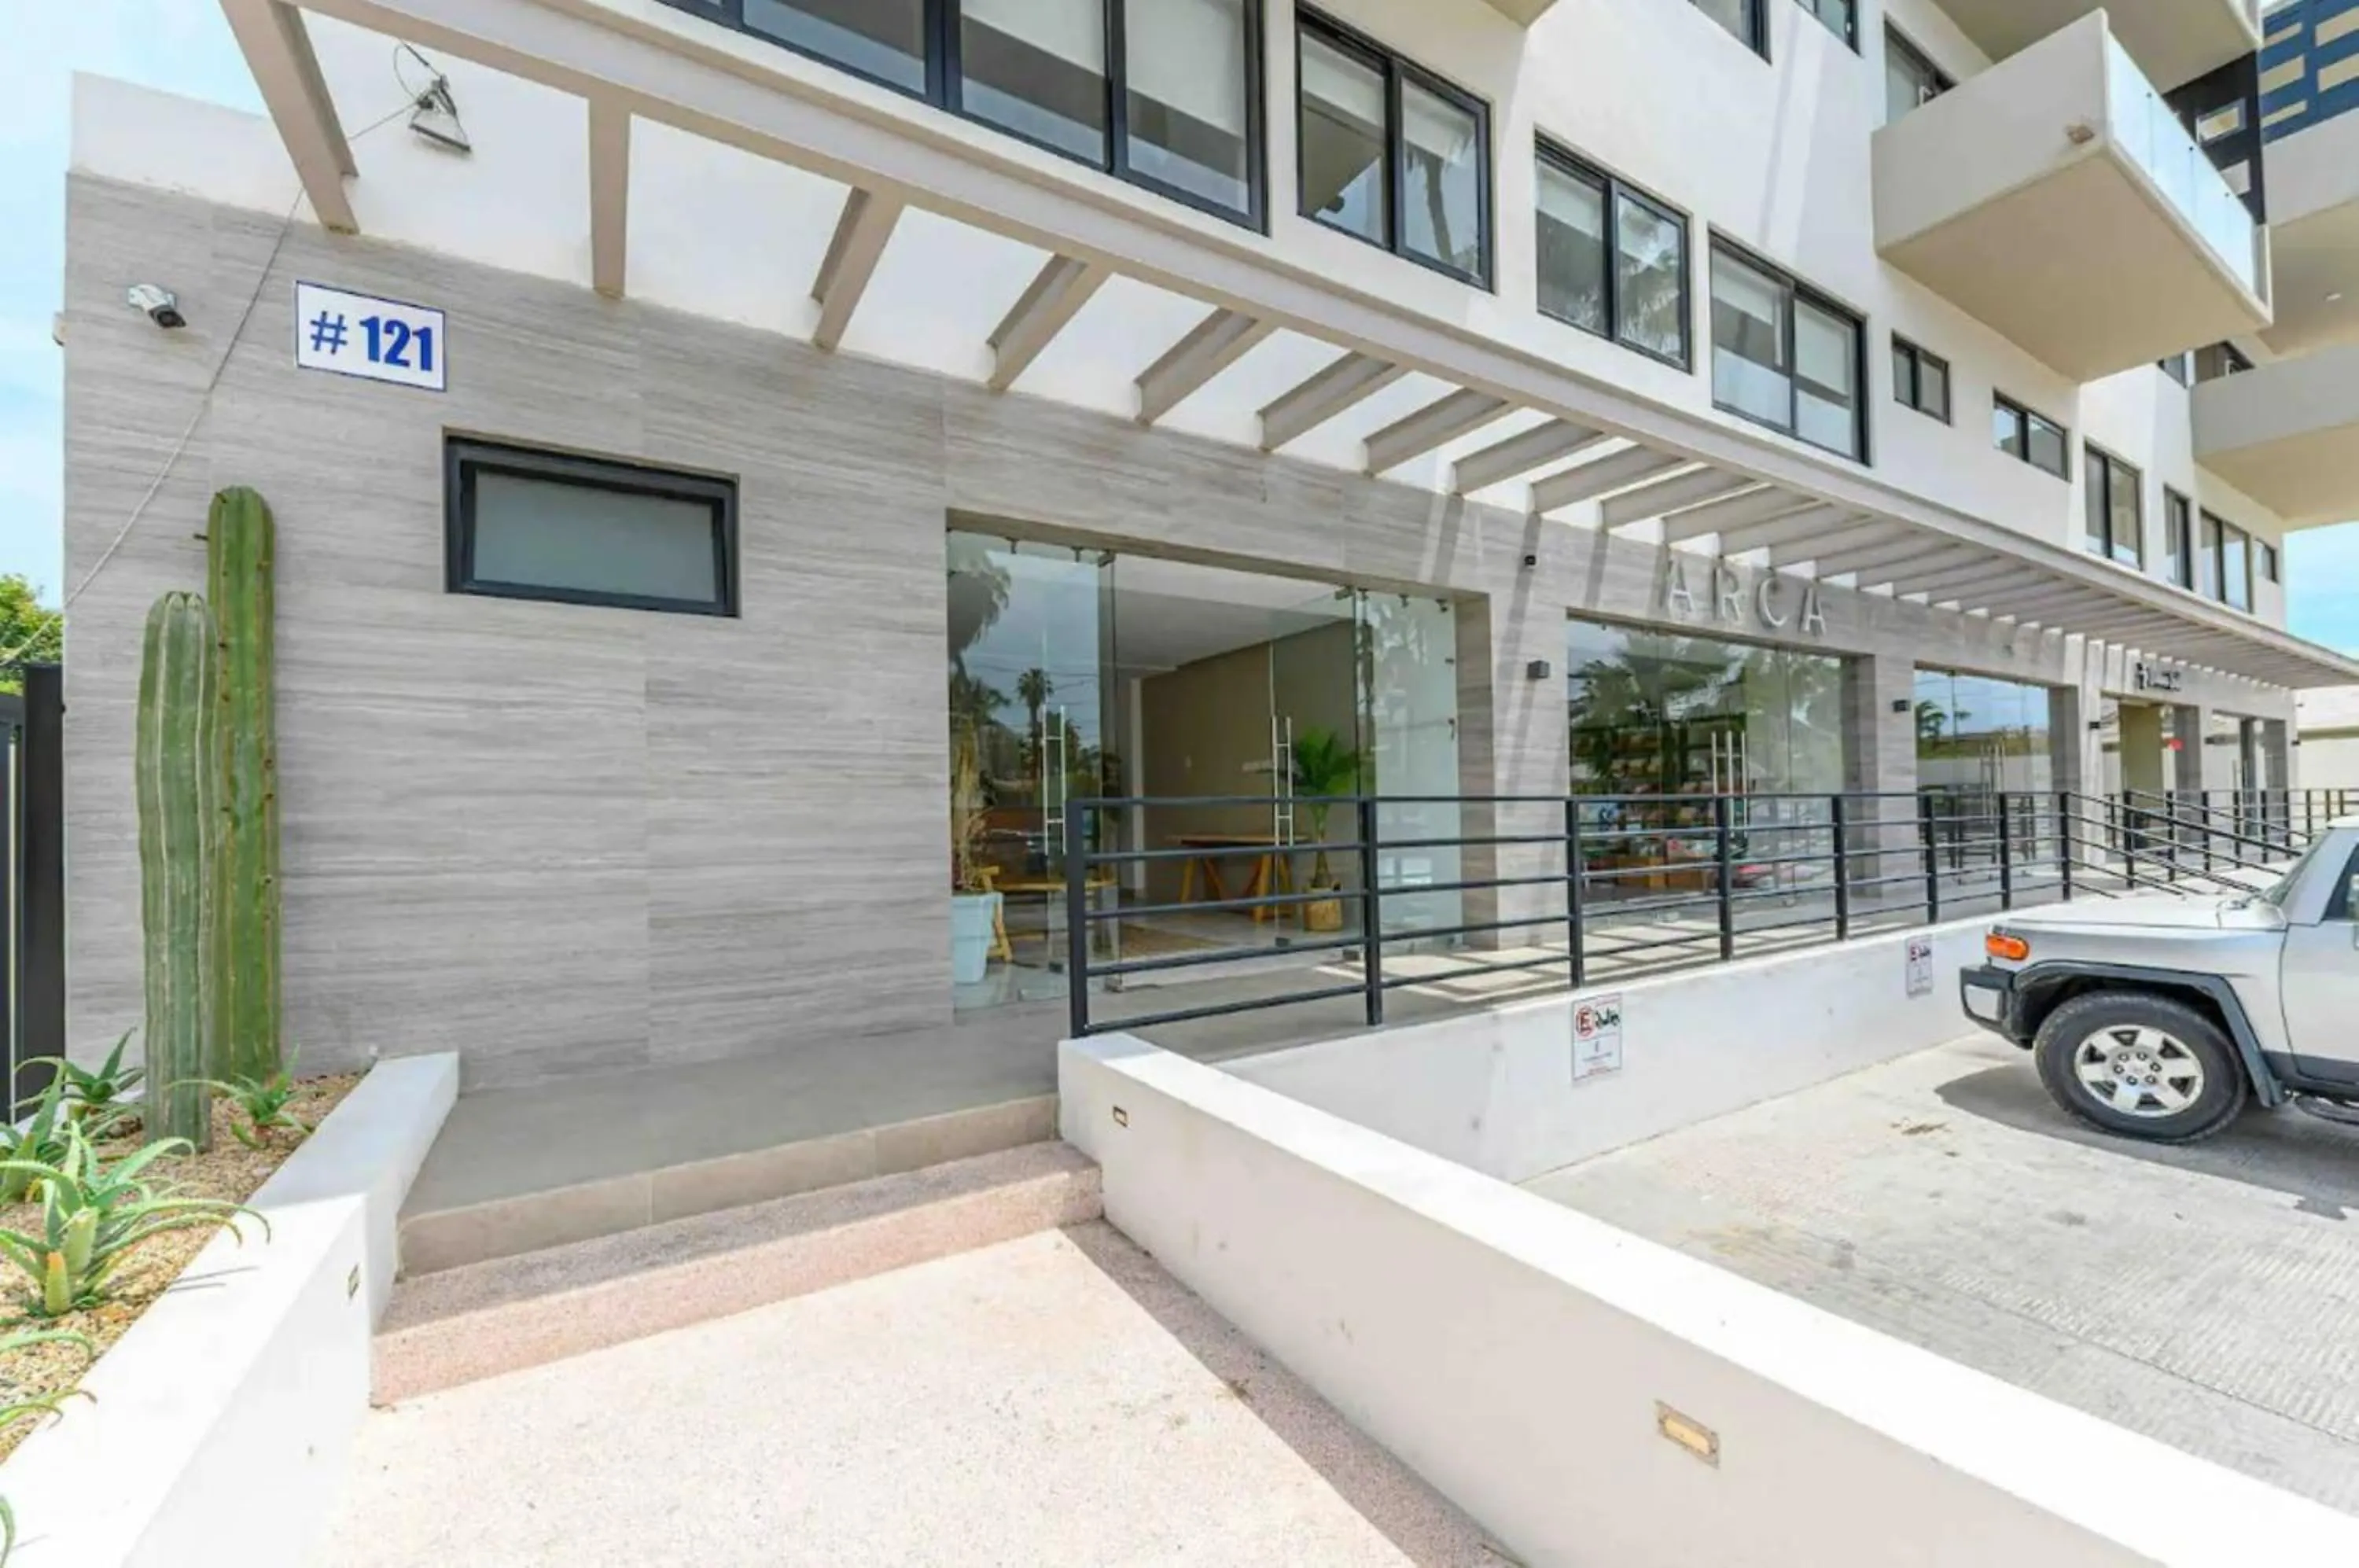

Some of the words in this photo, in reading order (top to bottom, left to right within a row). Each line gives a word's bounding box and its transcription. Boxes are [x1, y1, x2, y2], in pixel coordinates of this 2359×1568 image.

[311, 311, 348, 355] #
[359, 315, 432, 372] 121
[1666, 554, 1827, 635] ARCA
